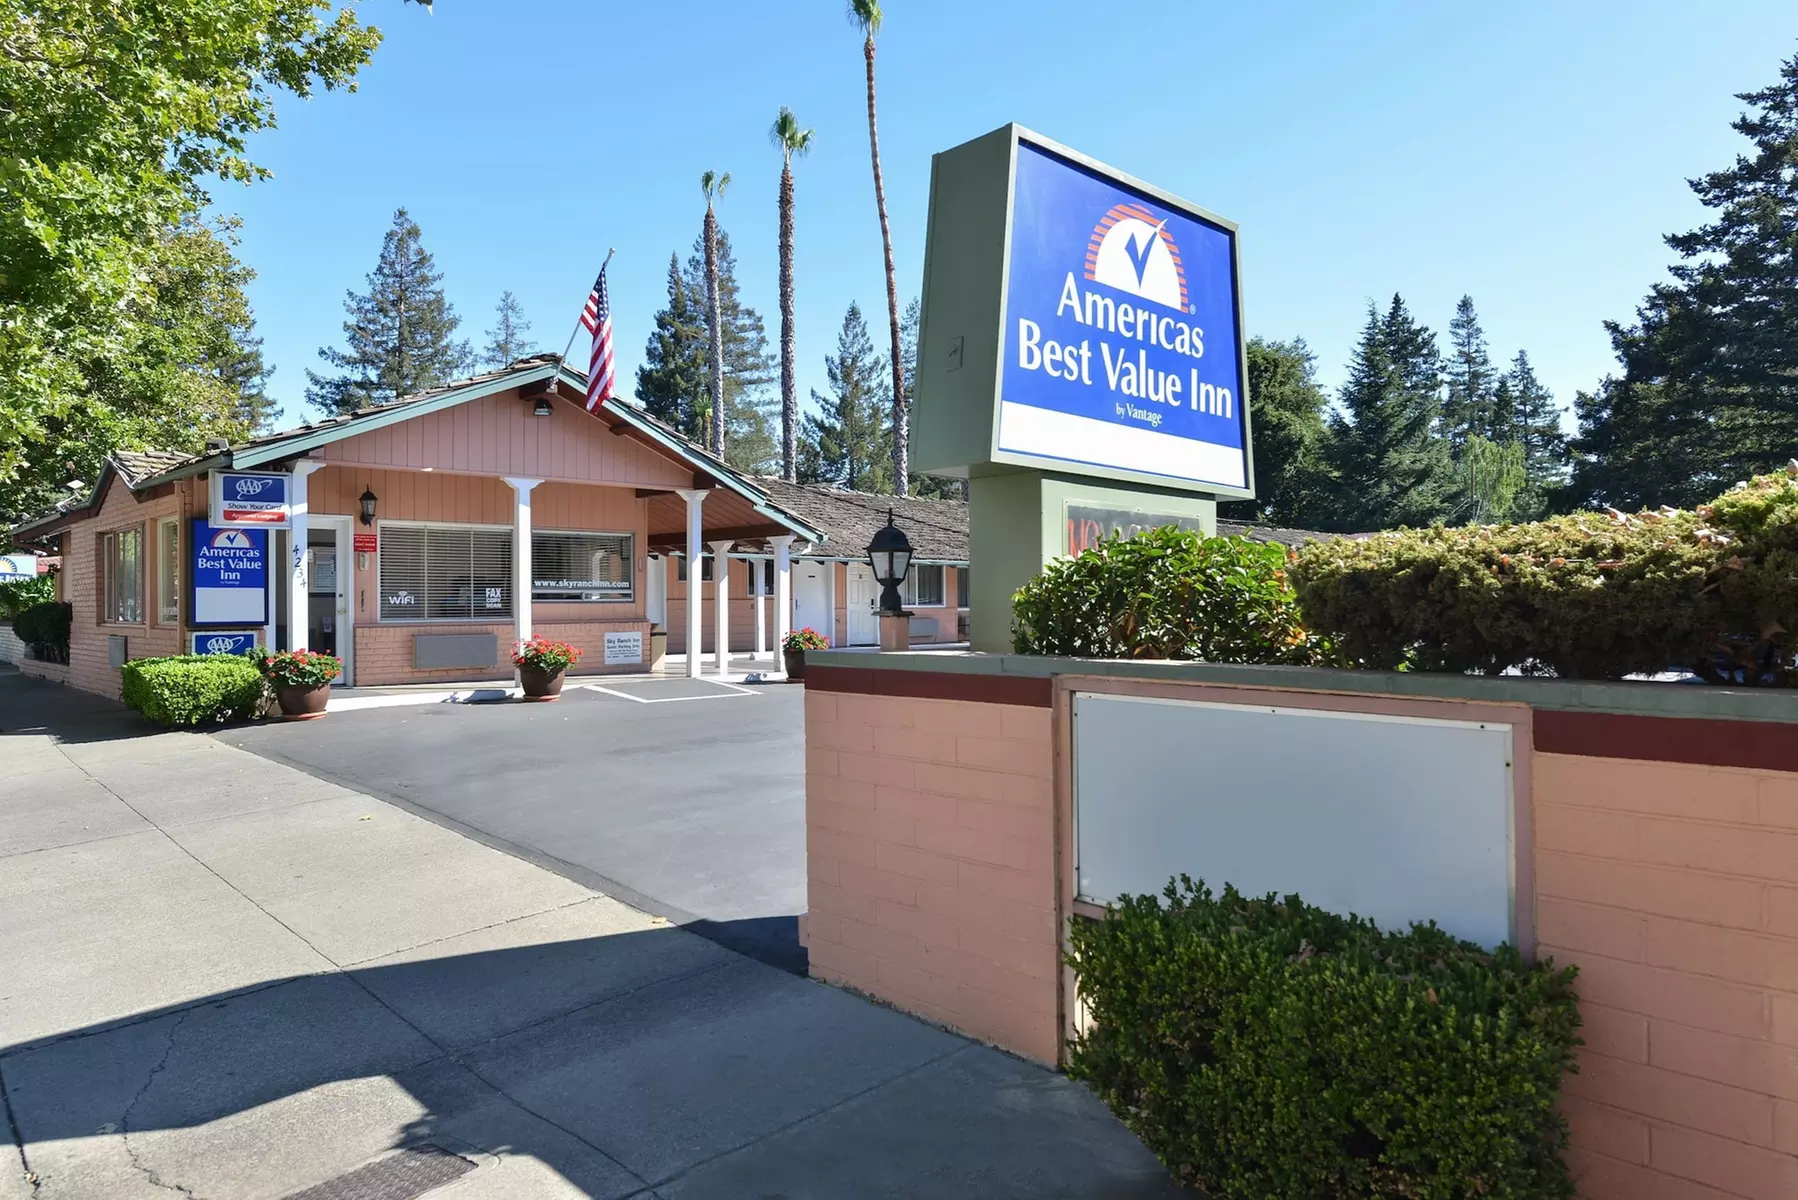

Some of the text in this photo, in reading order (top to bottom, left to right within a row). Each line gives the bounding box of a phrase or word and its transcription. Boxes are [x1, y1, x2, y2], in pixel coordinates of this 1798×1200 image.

[1057, 271, 1204, 359] Americas
[1019, 317, 1232, 419] Best Value Inn
[1115, 402, 1163, 428] by Vantage
[238, 479, 260, 494] AAA
[227, 502, 248, 510] Show
[199, 545, 260, 557] Americas
[198, 557, 262, 570] Best Value
[220, 569, 240, 580] Inn
[534, 579, 630, 588] www.skyranchinn.com
[485, 587, 502, 598] FAX
[209, 636, 231, 652] AAA
[606, 638, 616, 646] Sky
